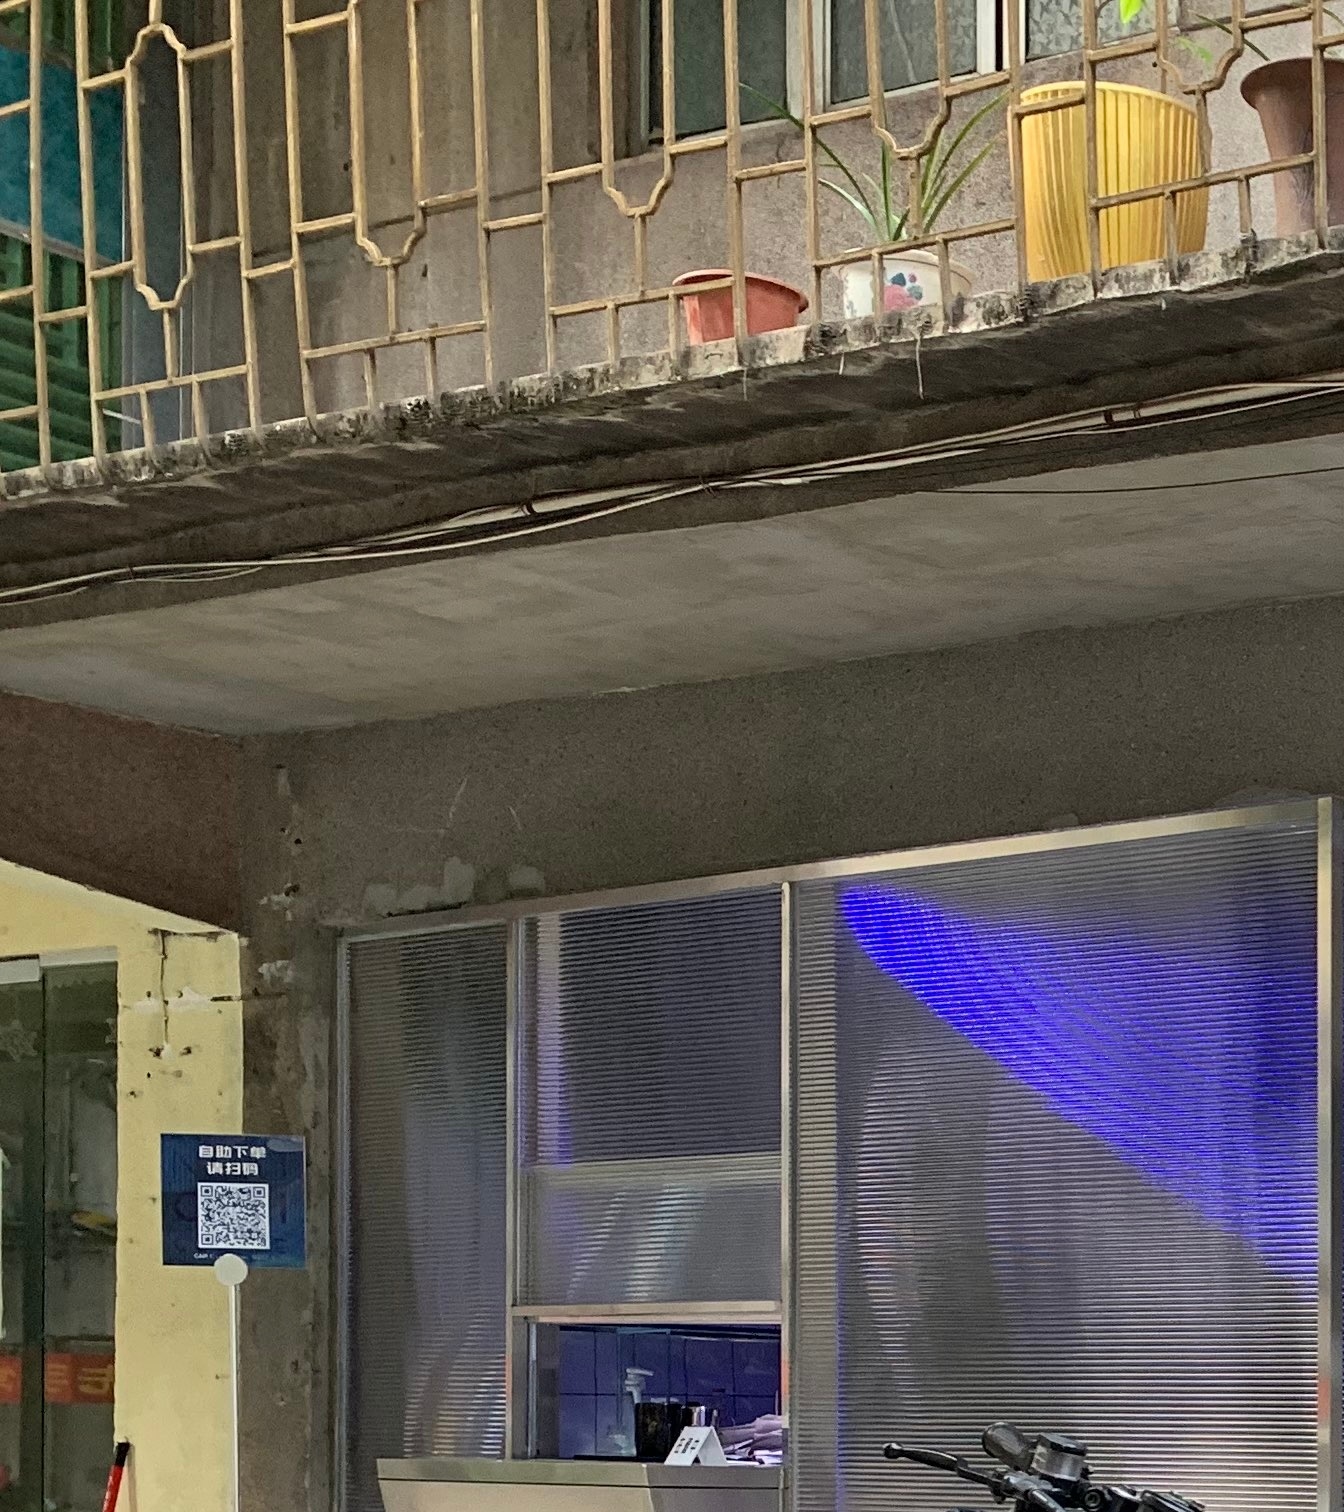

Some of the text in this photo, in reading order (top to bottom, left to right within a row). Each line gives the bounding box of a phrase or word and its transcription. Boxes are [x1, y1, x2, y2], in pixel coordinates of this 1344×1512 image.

[198, 1145, 267, 1159] 自助下单
[206, 1161, 259, 1176] 请扫码
